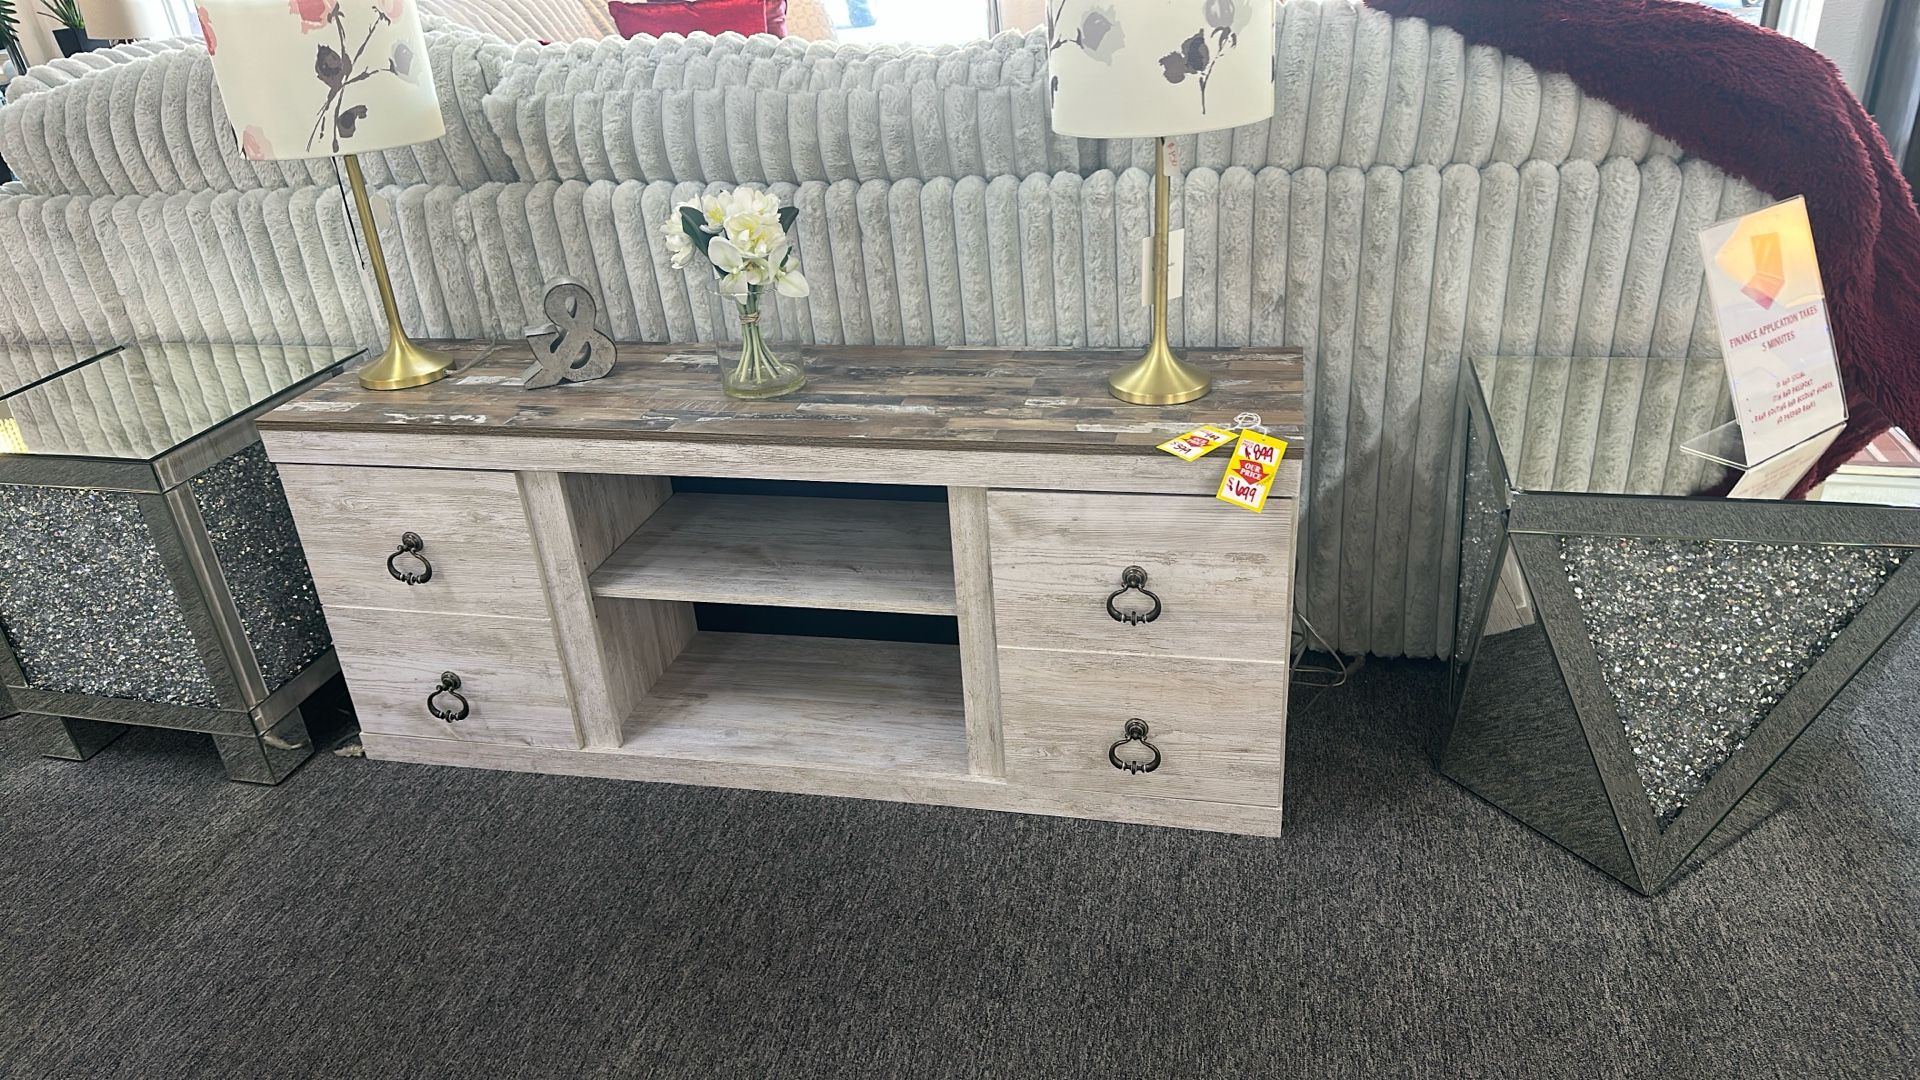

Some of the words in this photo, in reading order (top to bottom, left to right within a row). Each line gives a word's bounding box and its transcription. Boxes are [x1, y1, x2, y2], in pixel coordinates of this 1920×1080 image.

[1729, 330, 1757, 348] FINANCE
[1759, 313, 1798, 335] APPLICATION
[1800, 305, 1817, 319] TAKES
[1762, 342, 1767, 351] 5
[1768, 331, 1795, 349] MINUTES
[1240, 468, 1262, 480] PRICE
[1244, 463, 1261, 473] OUR
